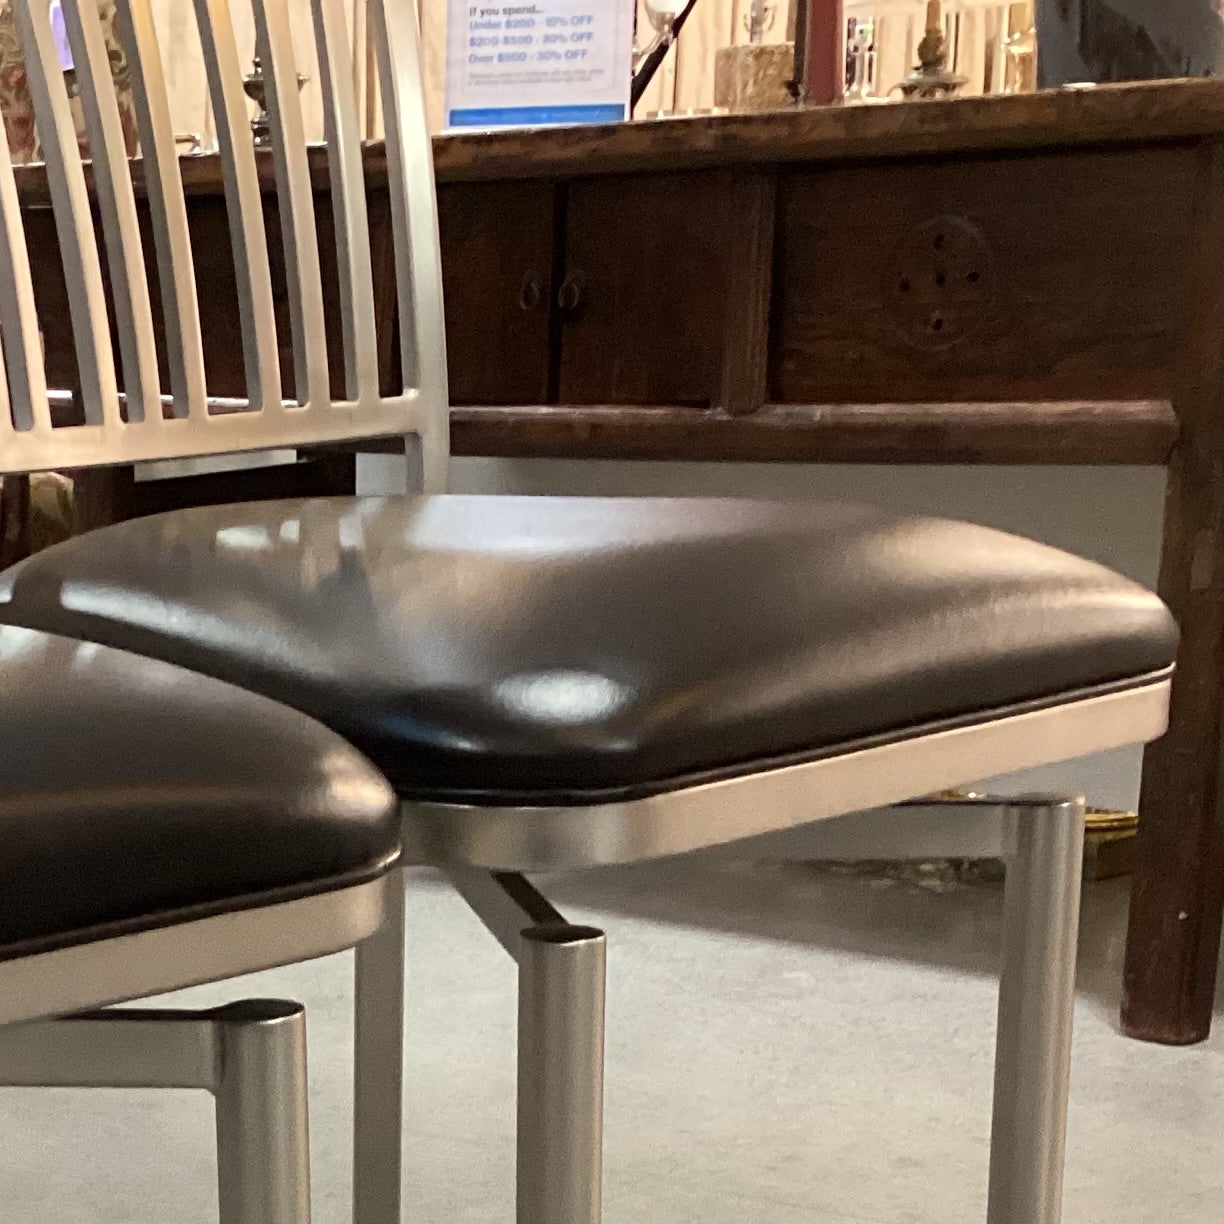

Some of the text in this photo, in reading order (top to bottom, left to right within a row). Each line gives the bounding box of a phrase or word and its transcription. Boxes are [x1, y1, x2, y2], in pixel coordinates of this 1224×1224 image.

[480, 8, 499, 17] you
[470, 21, 502, 30] Under
[570, 15, 594, 26] OFF
[570, 31, 594, 42] OFF
[469, 54, 494, 63] Over
[564, 49, 588, 60] OFF
